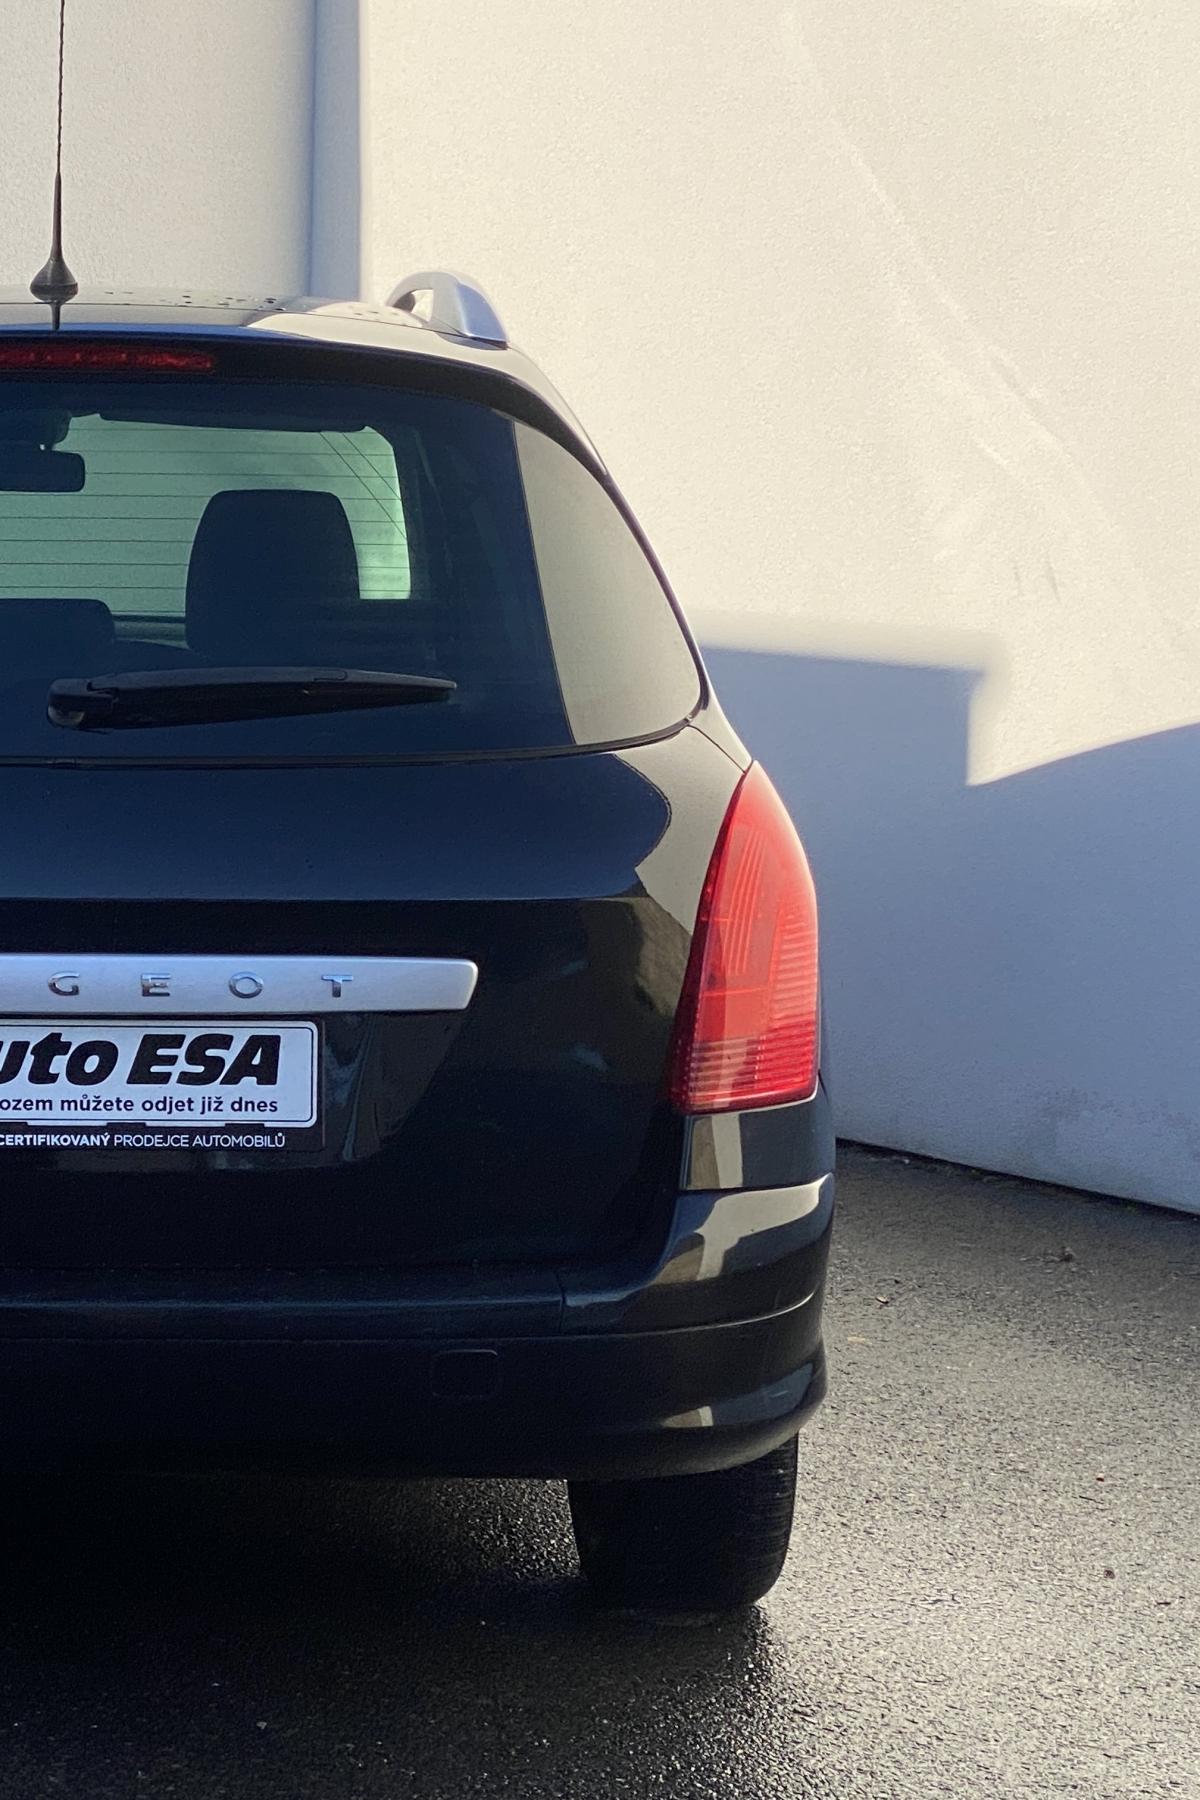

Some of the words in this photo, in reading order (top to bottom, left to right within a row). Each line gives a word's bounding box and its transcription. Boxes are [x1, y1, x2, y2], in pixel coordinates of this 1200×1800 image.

[126, 1033, 280, 1086] ESA
[60, 1094, 134, 1113] můžete
[141, 1095, 193, 1117] odjet
[200, 1094, 224, 1117] již
[230, 1096, 278, 1113] dnes
[114, 1134, 189, 1147] PRODEJCE
[193, 1131, 285, 1148] AUTOMOBILŮ
